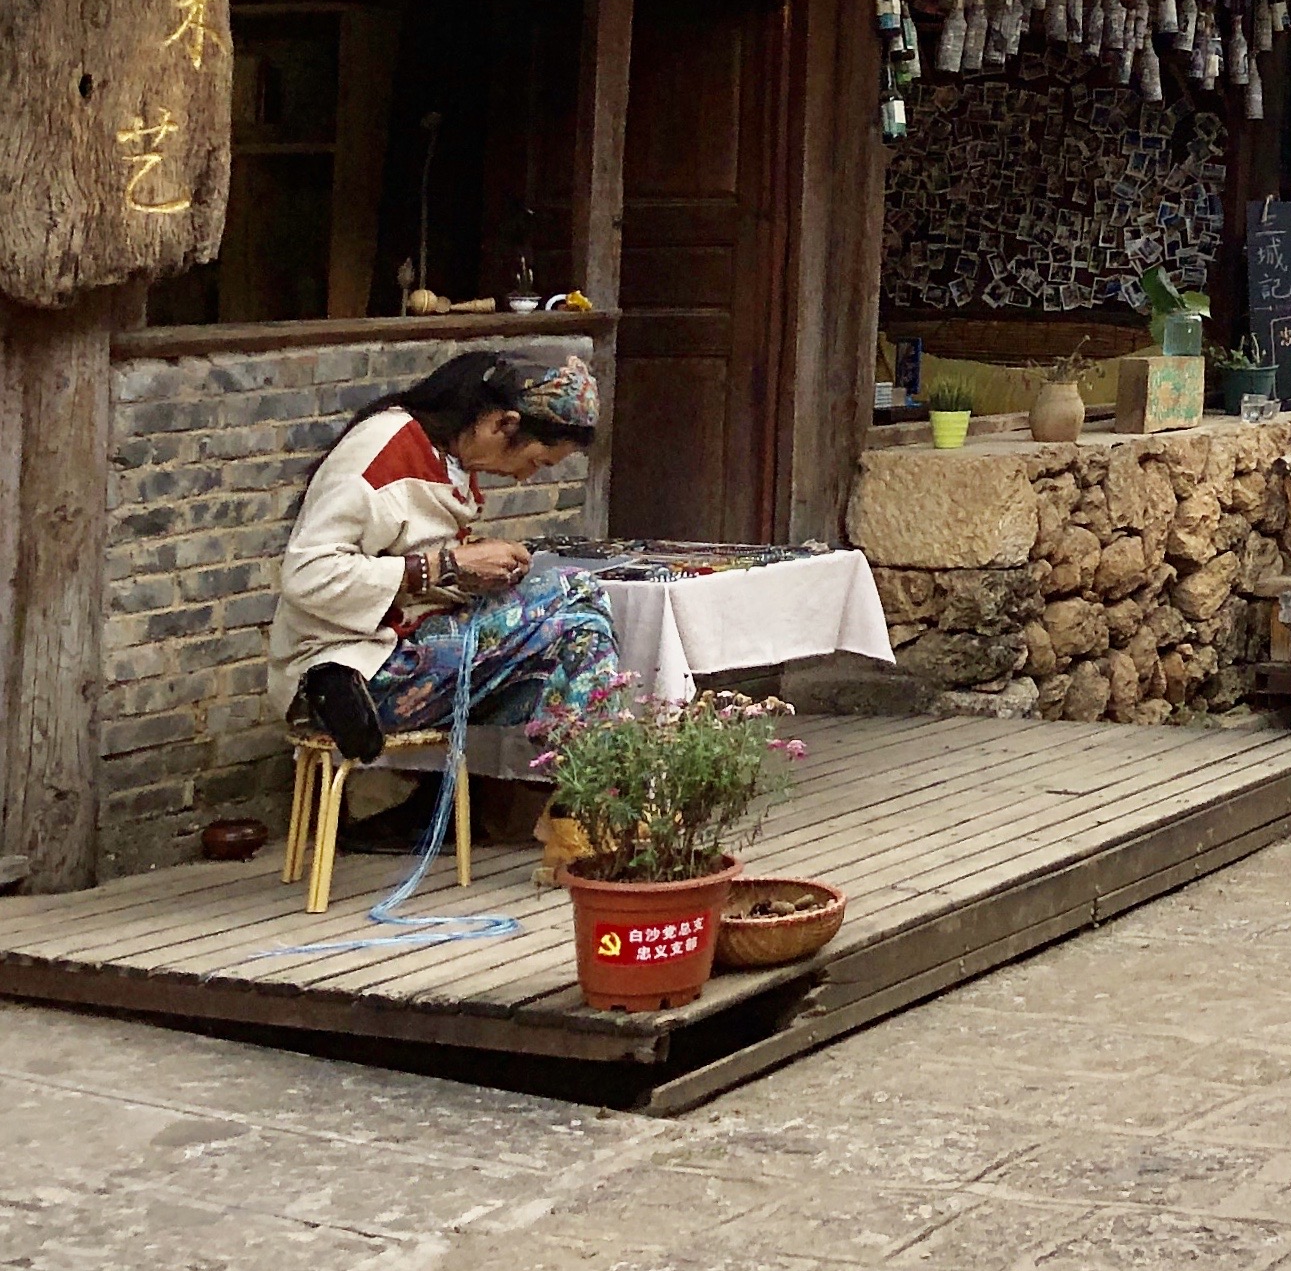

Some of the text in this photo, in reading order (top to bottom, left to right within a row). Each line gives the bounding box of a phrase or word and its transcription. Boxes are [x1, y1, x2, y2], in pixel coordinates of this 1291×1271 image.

[628, 916, 705, 944] 白沙党总支
[636, 936, 698, 961] 忠义支部
